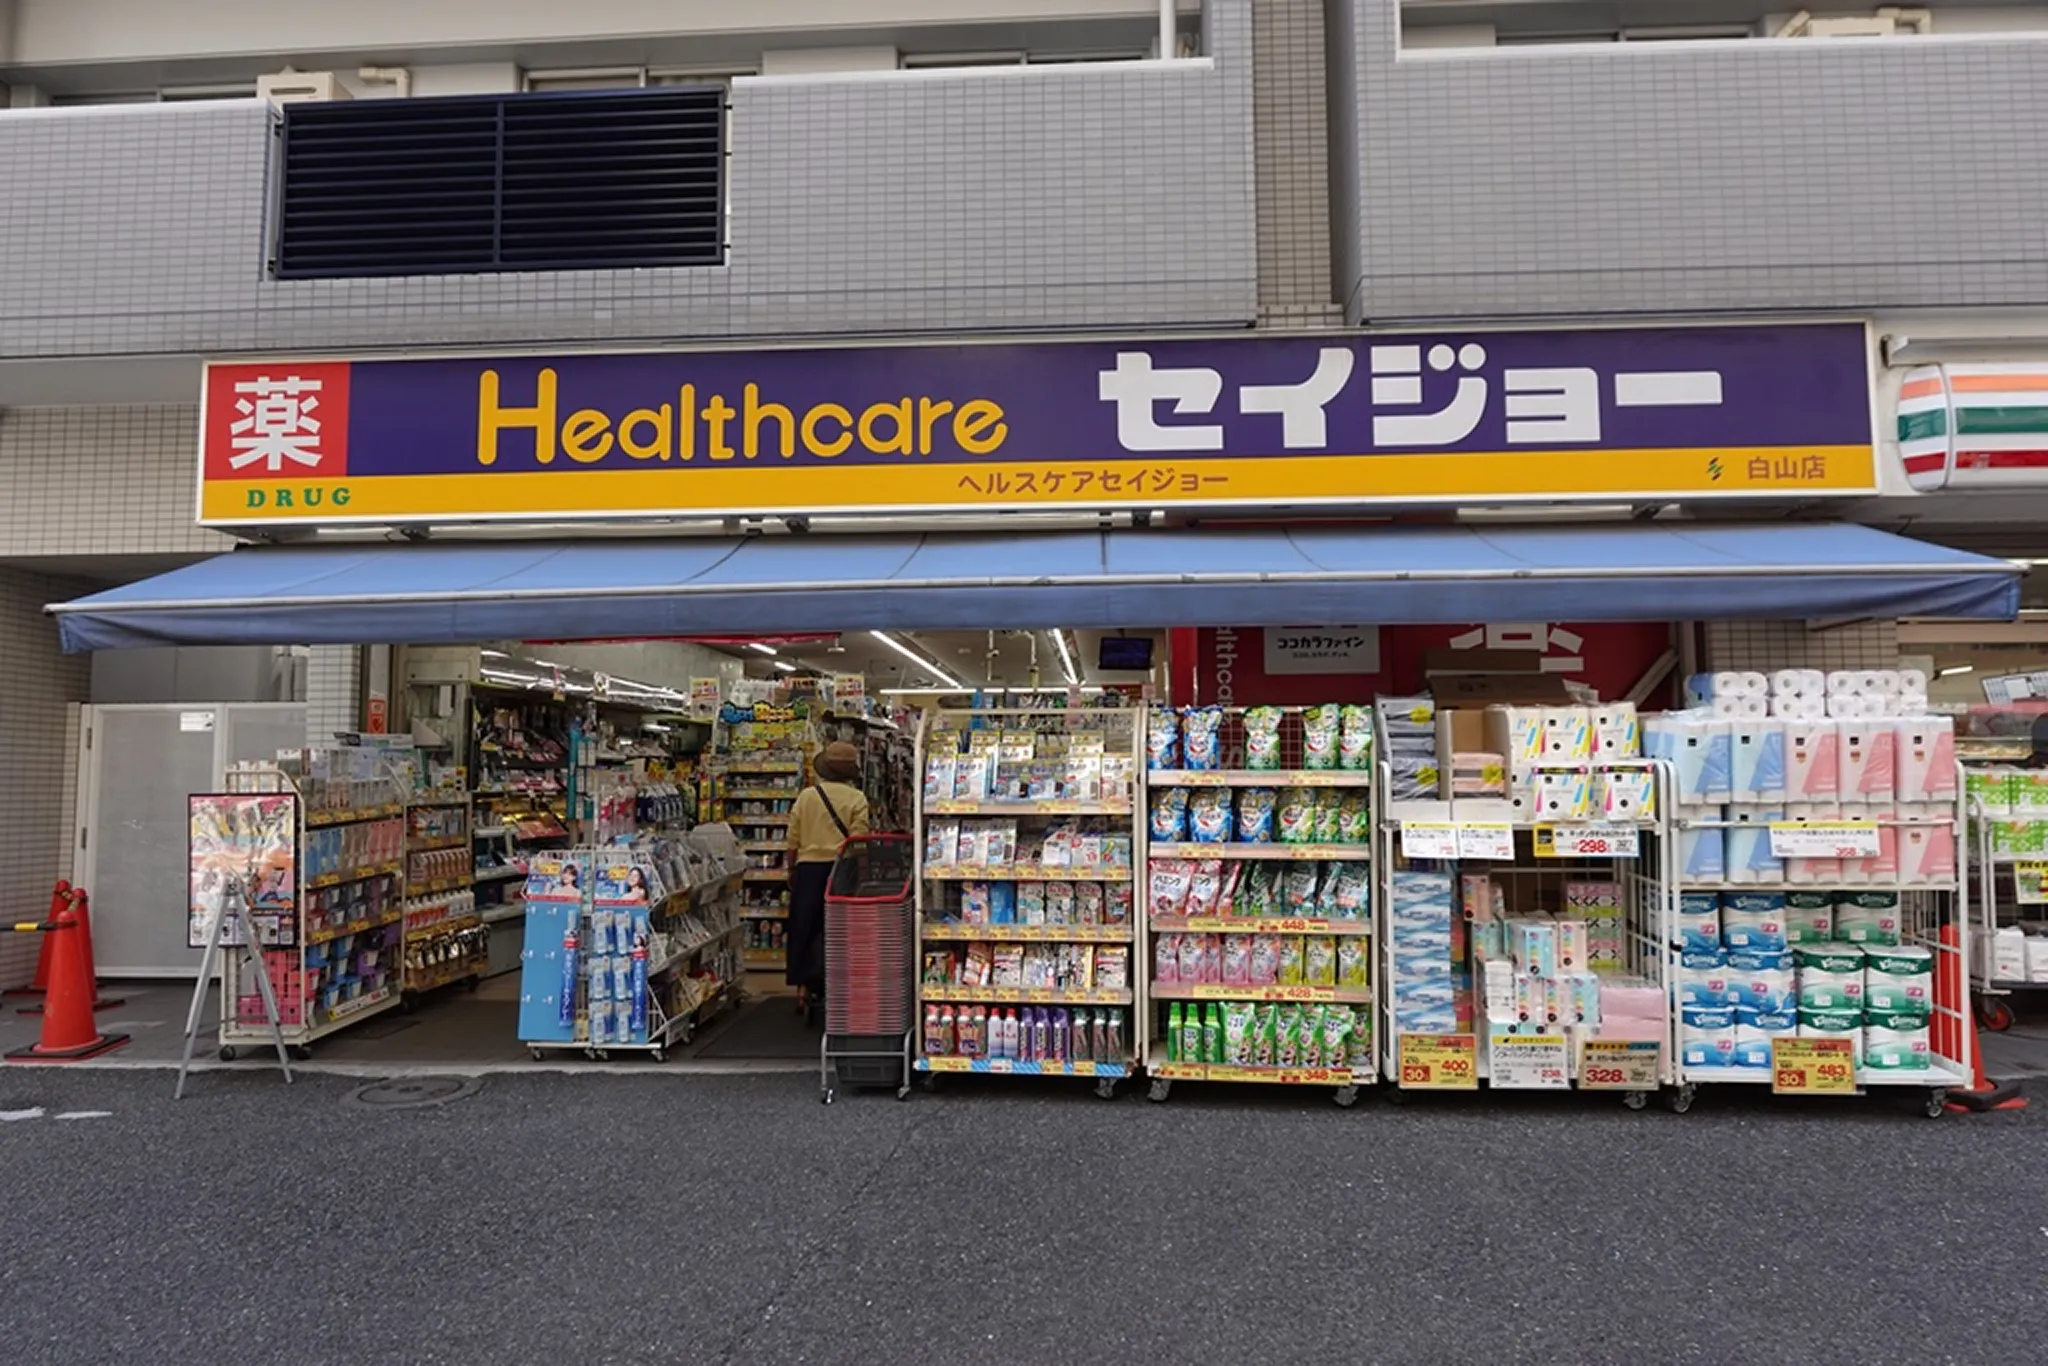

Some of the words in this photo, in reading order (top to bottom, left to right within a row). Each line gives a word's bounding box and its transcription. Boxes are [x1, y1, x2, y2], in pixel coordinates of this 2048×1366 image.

[1099, 342, 1723, 452] セイジョー
[229, 376, 323, 471] 薬
[477, 367, 1009, 466] Healthcare
[1747, 456, 1826, 481] 白山店
[958, 468, 1230, 495] ヘルスケアセイジョー
[246, 487, 352, 508] DRUG
[1277, 636, 1365, 649] ココカラファイン
[1442, 1060, 1469, 1072] 400
[1586, 1069, 1623, 1083] 328
